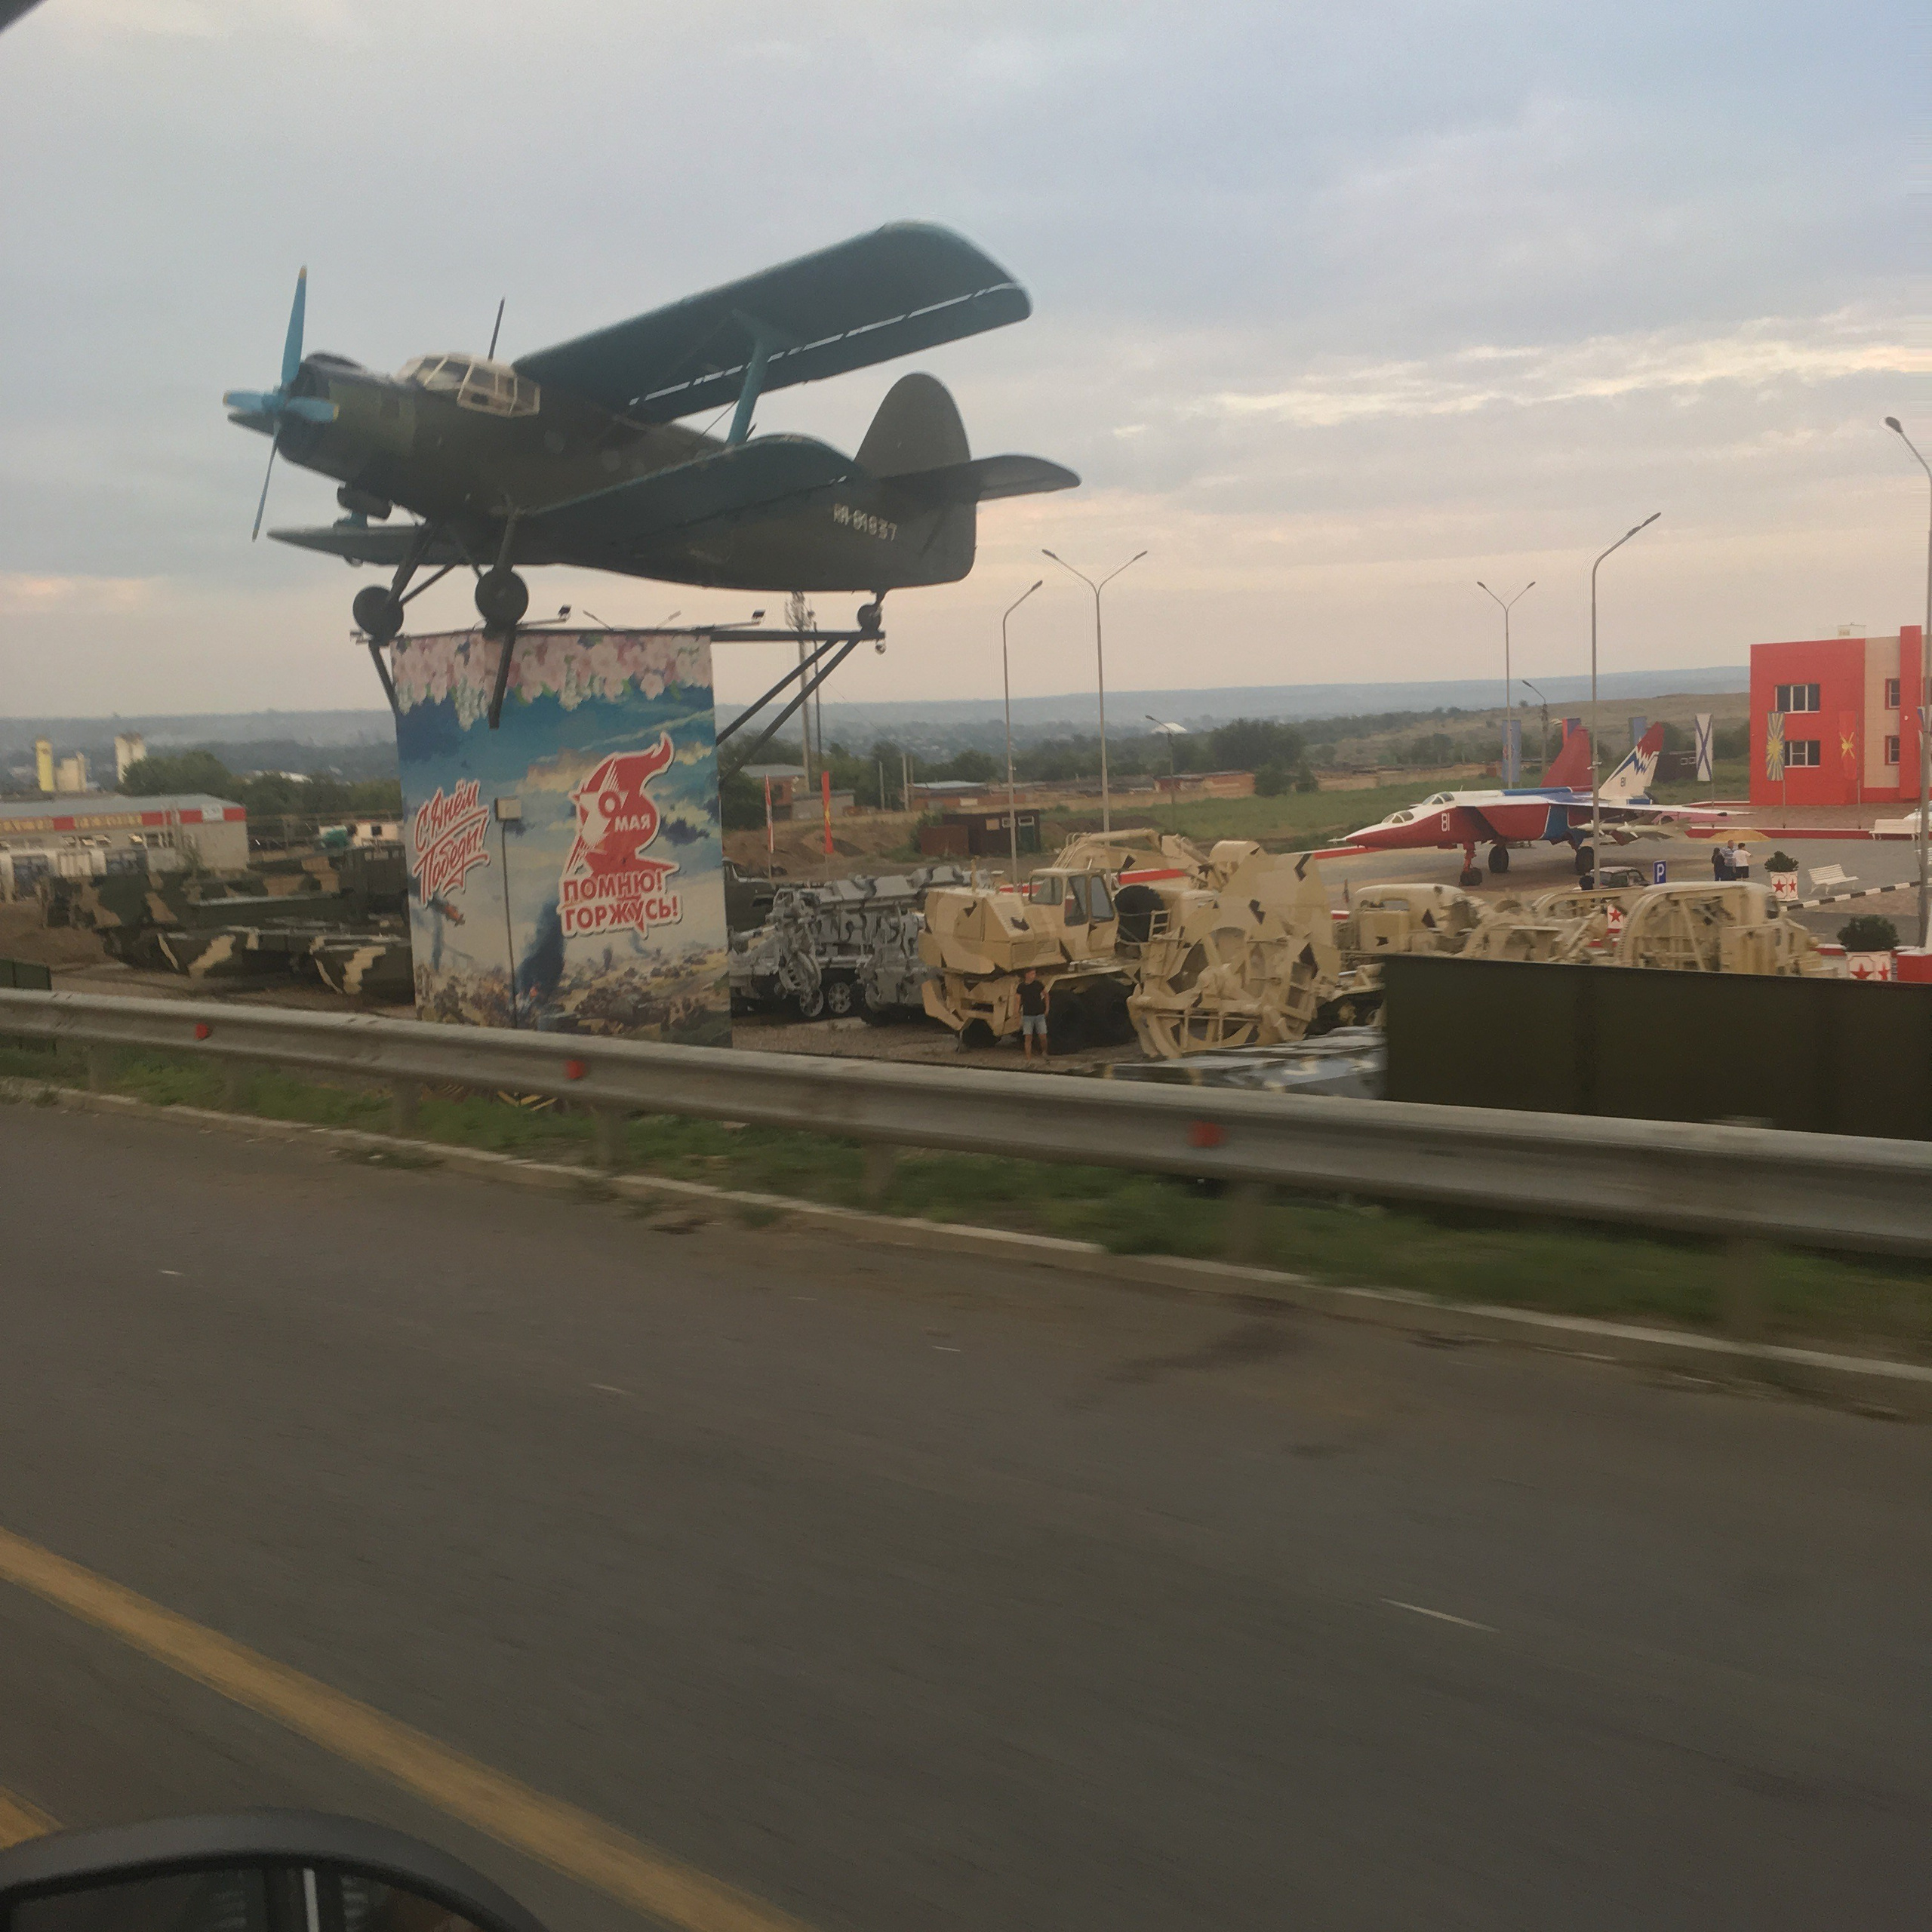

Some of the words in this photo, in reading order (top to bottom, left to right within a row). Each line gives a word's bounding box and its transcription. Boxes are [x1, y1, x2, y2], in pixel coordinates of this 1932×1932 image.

[614, 814, 652, 832] МАЯ
[1441, 813, 1451, 832] 81
[1657, 863, 1665, 882] P
[563, 871, 662, 901] ПОМНЮ!
[565, 894, 678, 933] ГОРЖУСЬ!
